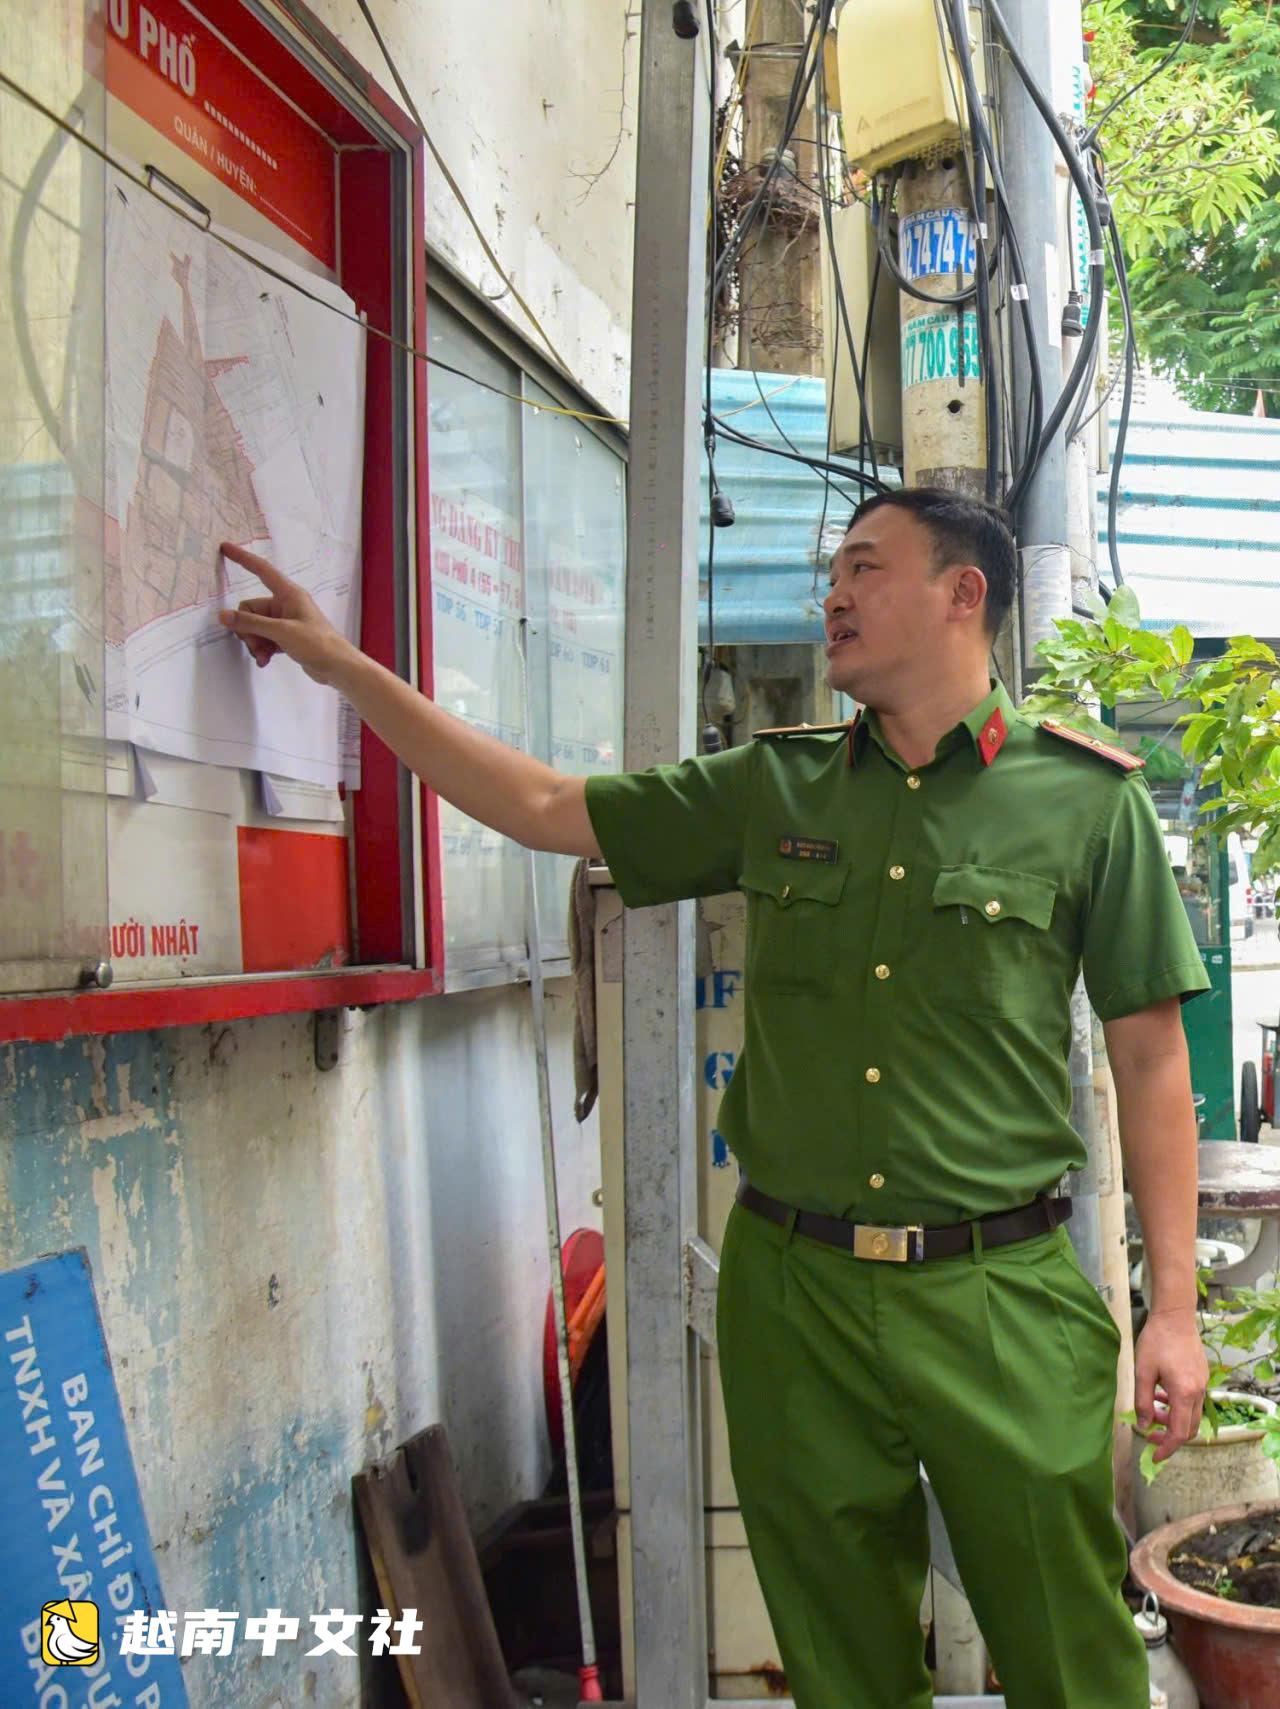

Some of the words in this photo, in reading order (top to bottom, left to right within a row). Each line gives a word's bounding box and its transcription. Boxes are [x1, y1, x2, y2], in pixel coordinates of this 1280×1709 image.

[109, 0, 129, 39] U
[105, 918, 145, 958] ƯỜI
[151, 918, 199, 963] NHẬT
[5, 1314, 56, 1456] TNXH
[62, 1373, 105, 1478] BAN
[37, 1457, 76, 1533] VÀ
[88, 1485, 133, 1568] CHỈ
[52, 1533, 93, 1601] XÂ
[107, 1571, 151, 1678] ĐO
